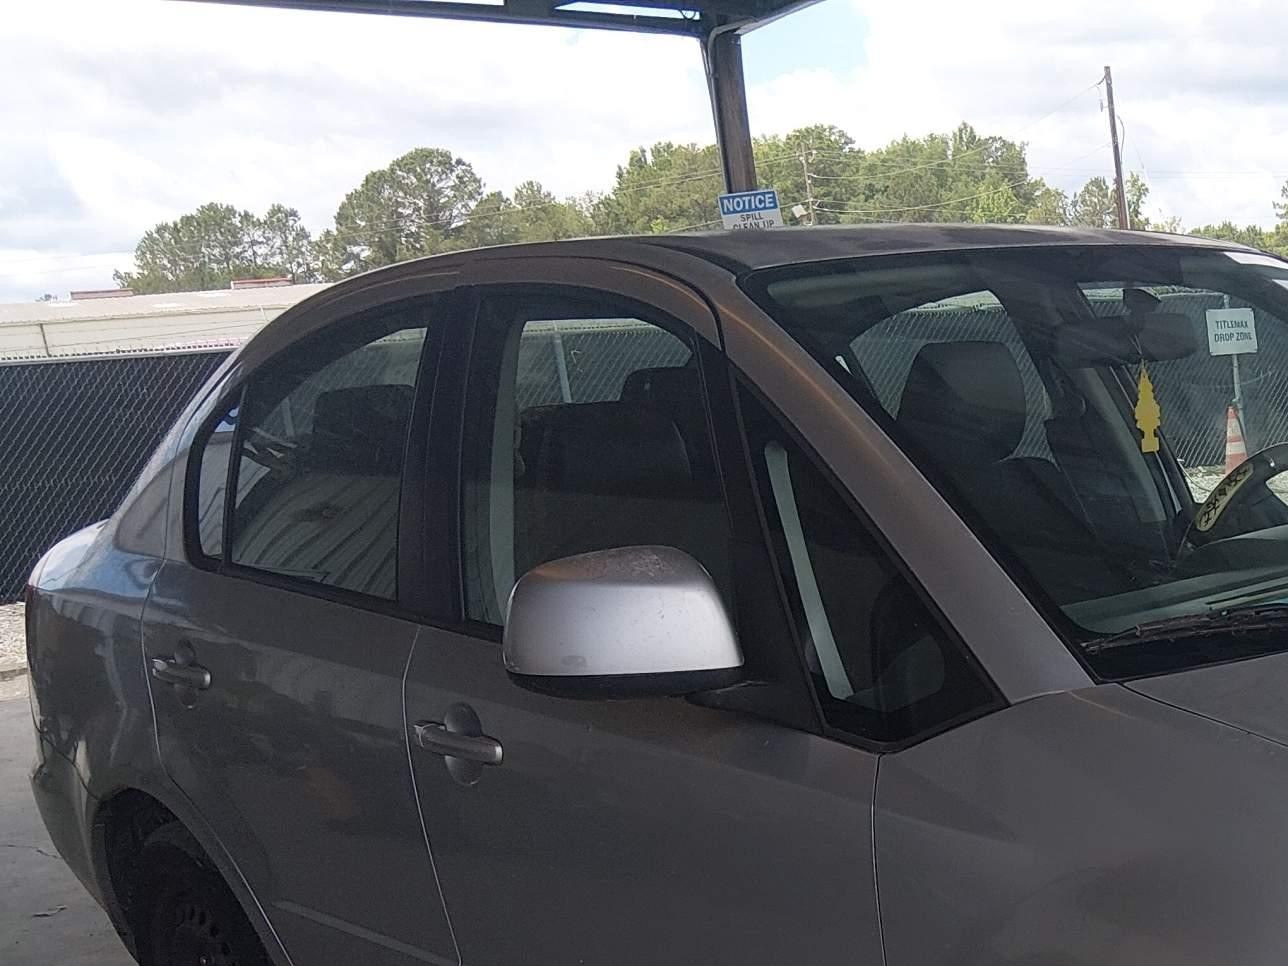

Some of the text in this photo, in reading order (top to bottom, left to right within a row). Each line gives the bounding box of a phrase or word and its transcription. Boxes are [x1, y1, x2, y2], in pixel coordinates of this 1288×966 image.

[723, 194, 774, 212] NOTICE
[740, 212, 764, 222] SPILL
[1214, 332, 1252, 342] DROP ZONE
